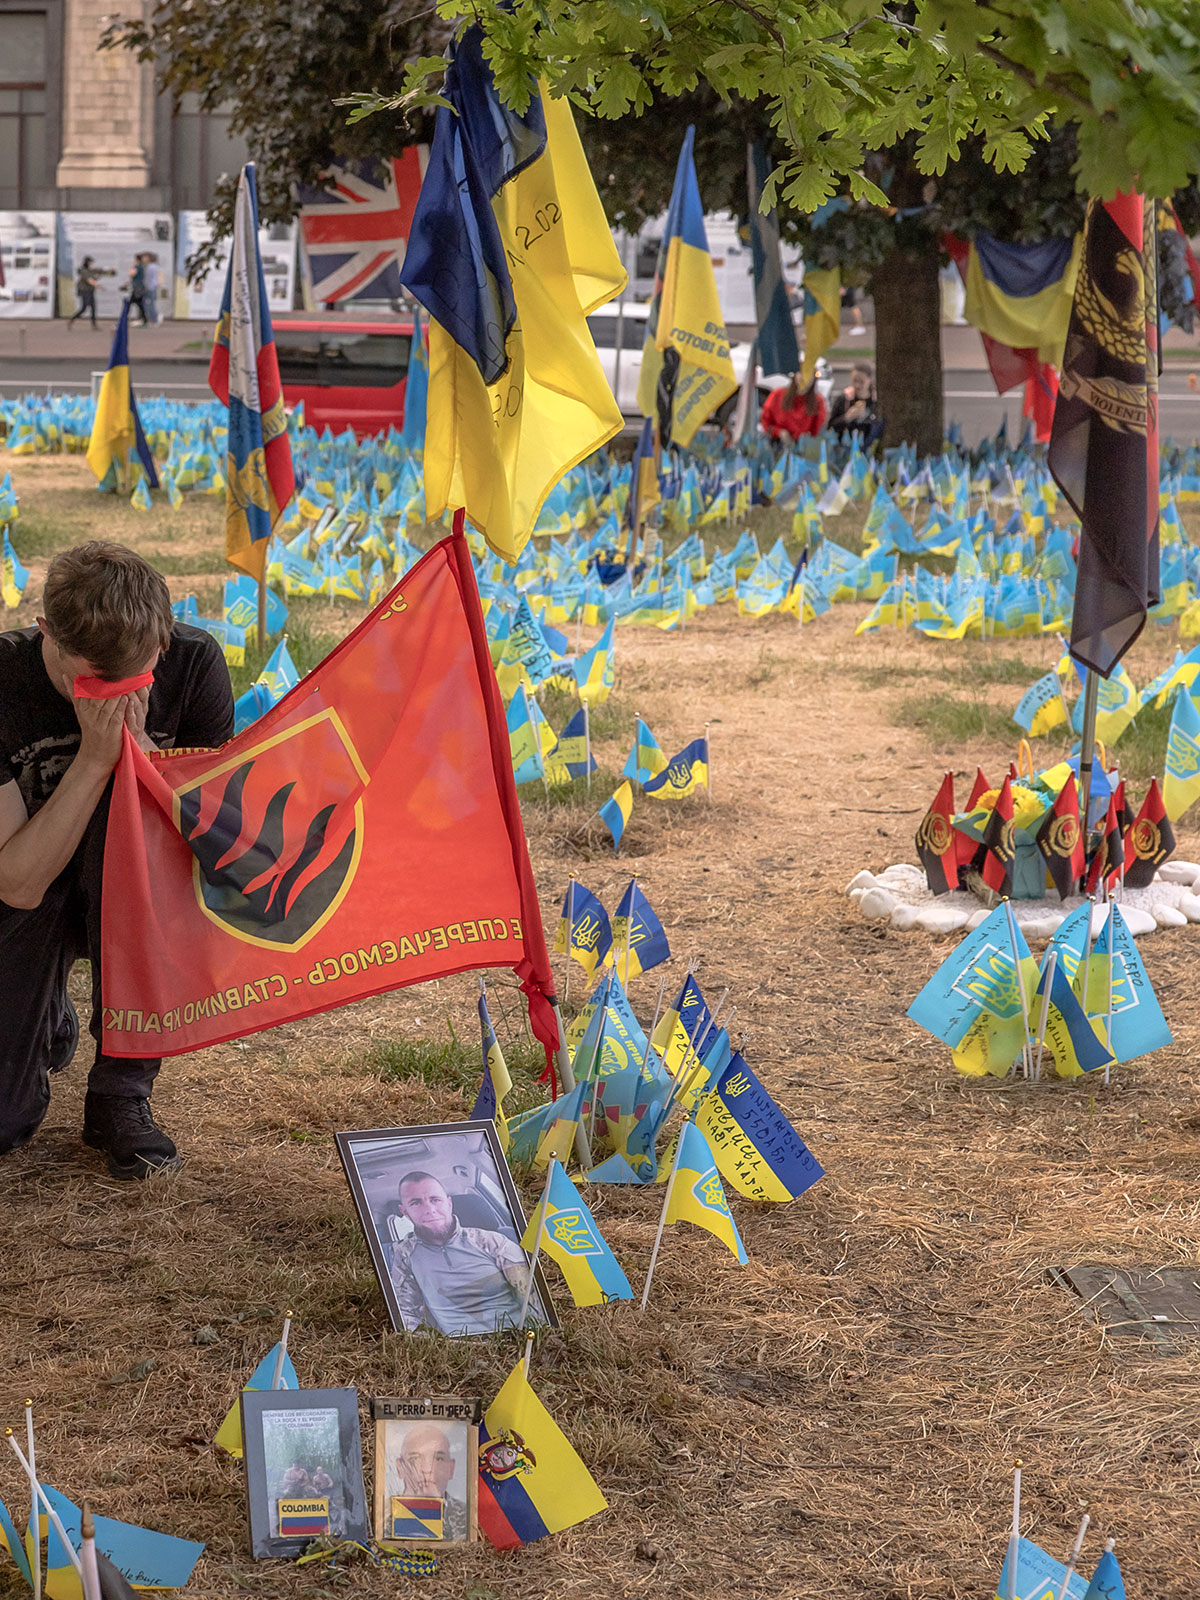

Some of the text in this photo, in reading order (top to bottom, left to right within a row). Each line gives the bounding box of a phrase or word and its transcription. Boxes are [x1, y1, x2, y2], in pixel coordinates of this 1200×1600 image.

[383, 1404, 394, 1415] EL
[397, 1403, 426, 1415] PERRO
[282, 1504, 326, 1513] COLOMBIA
